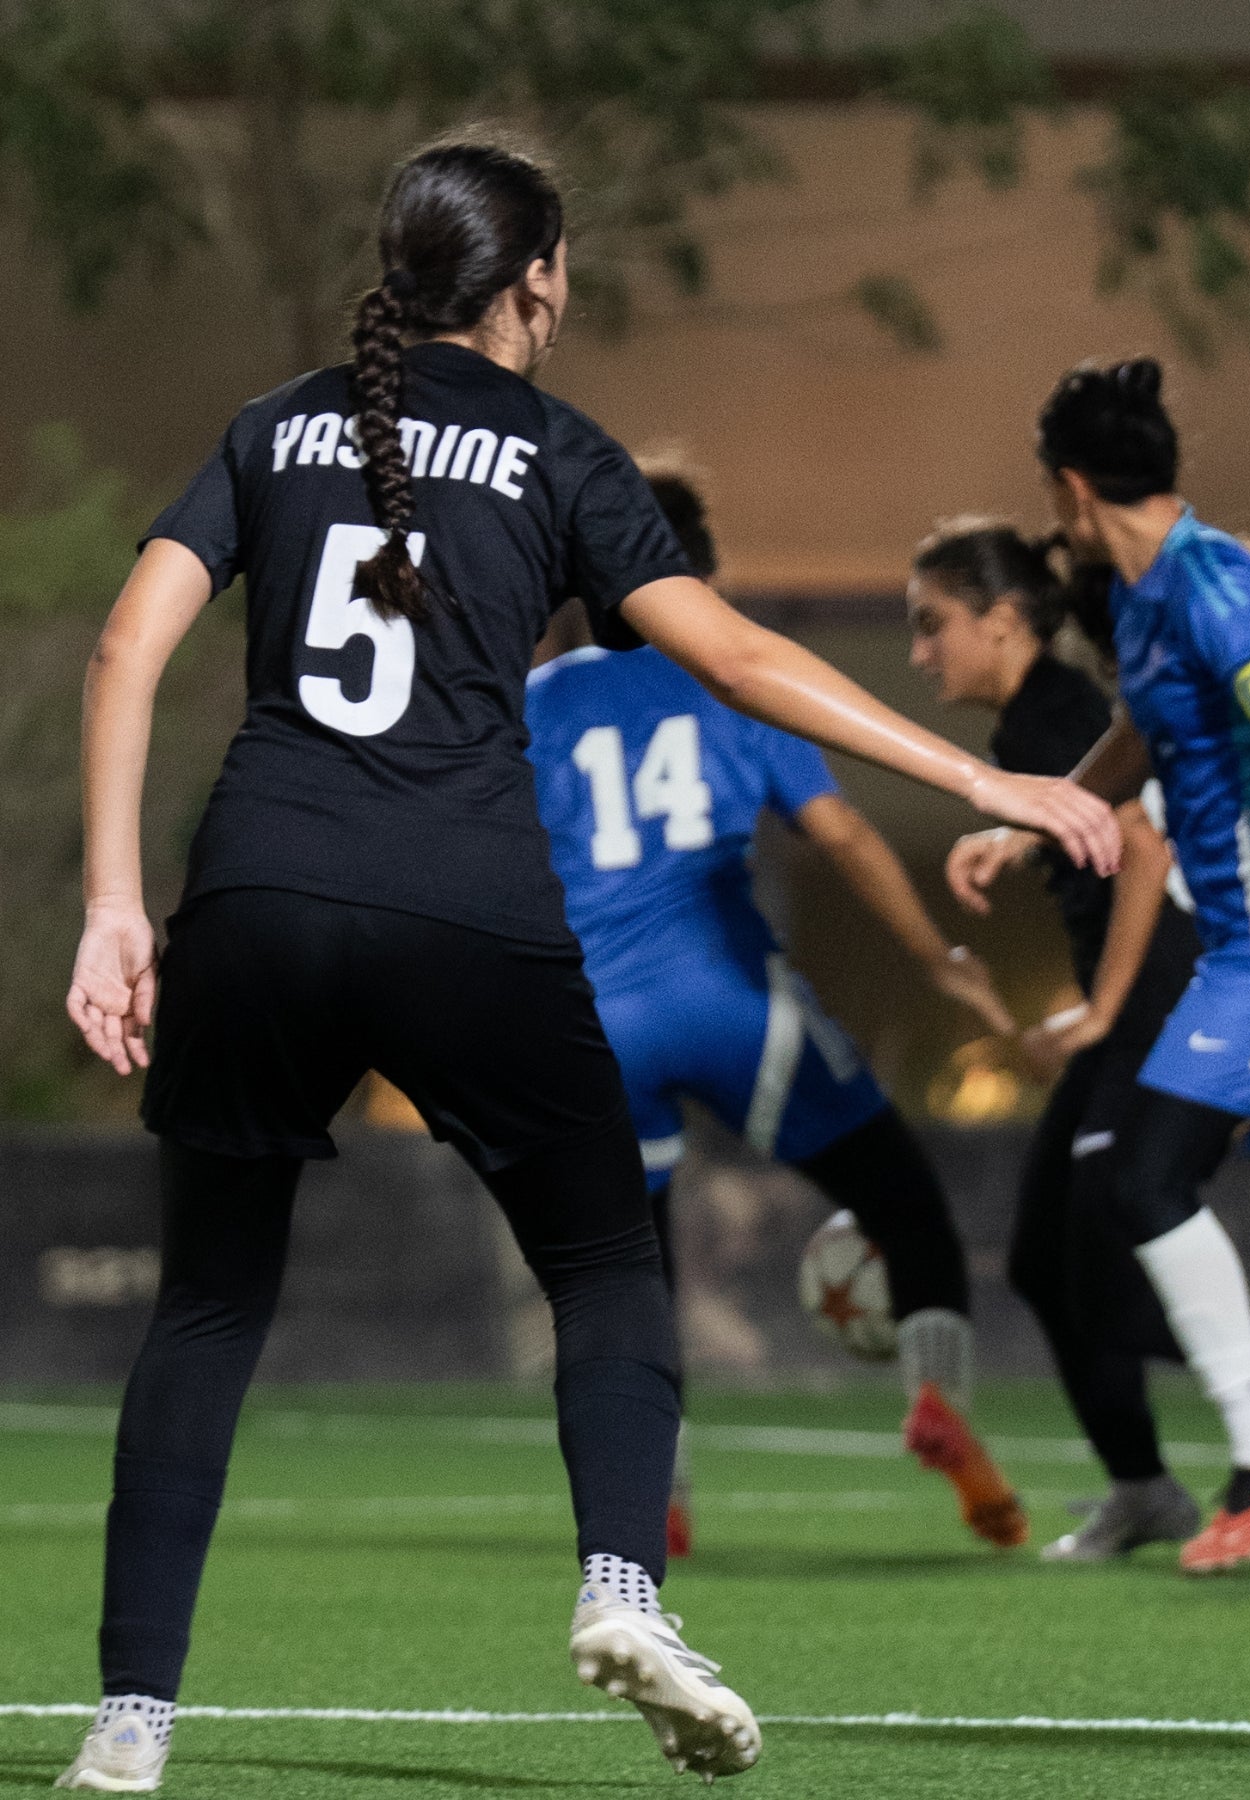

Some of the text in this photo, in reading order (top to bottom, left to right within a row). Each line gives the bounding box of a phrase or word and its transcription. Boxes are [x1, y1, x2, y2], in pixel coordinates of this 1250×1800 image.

[272, 412, 539, 500] YASMINE
[298, 523, 426, 737] 5
[572, 714, 714, 870] 14
